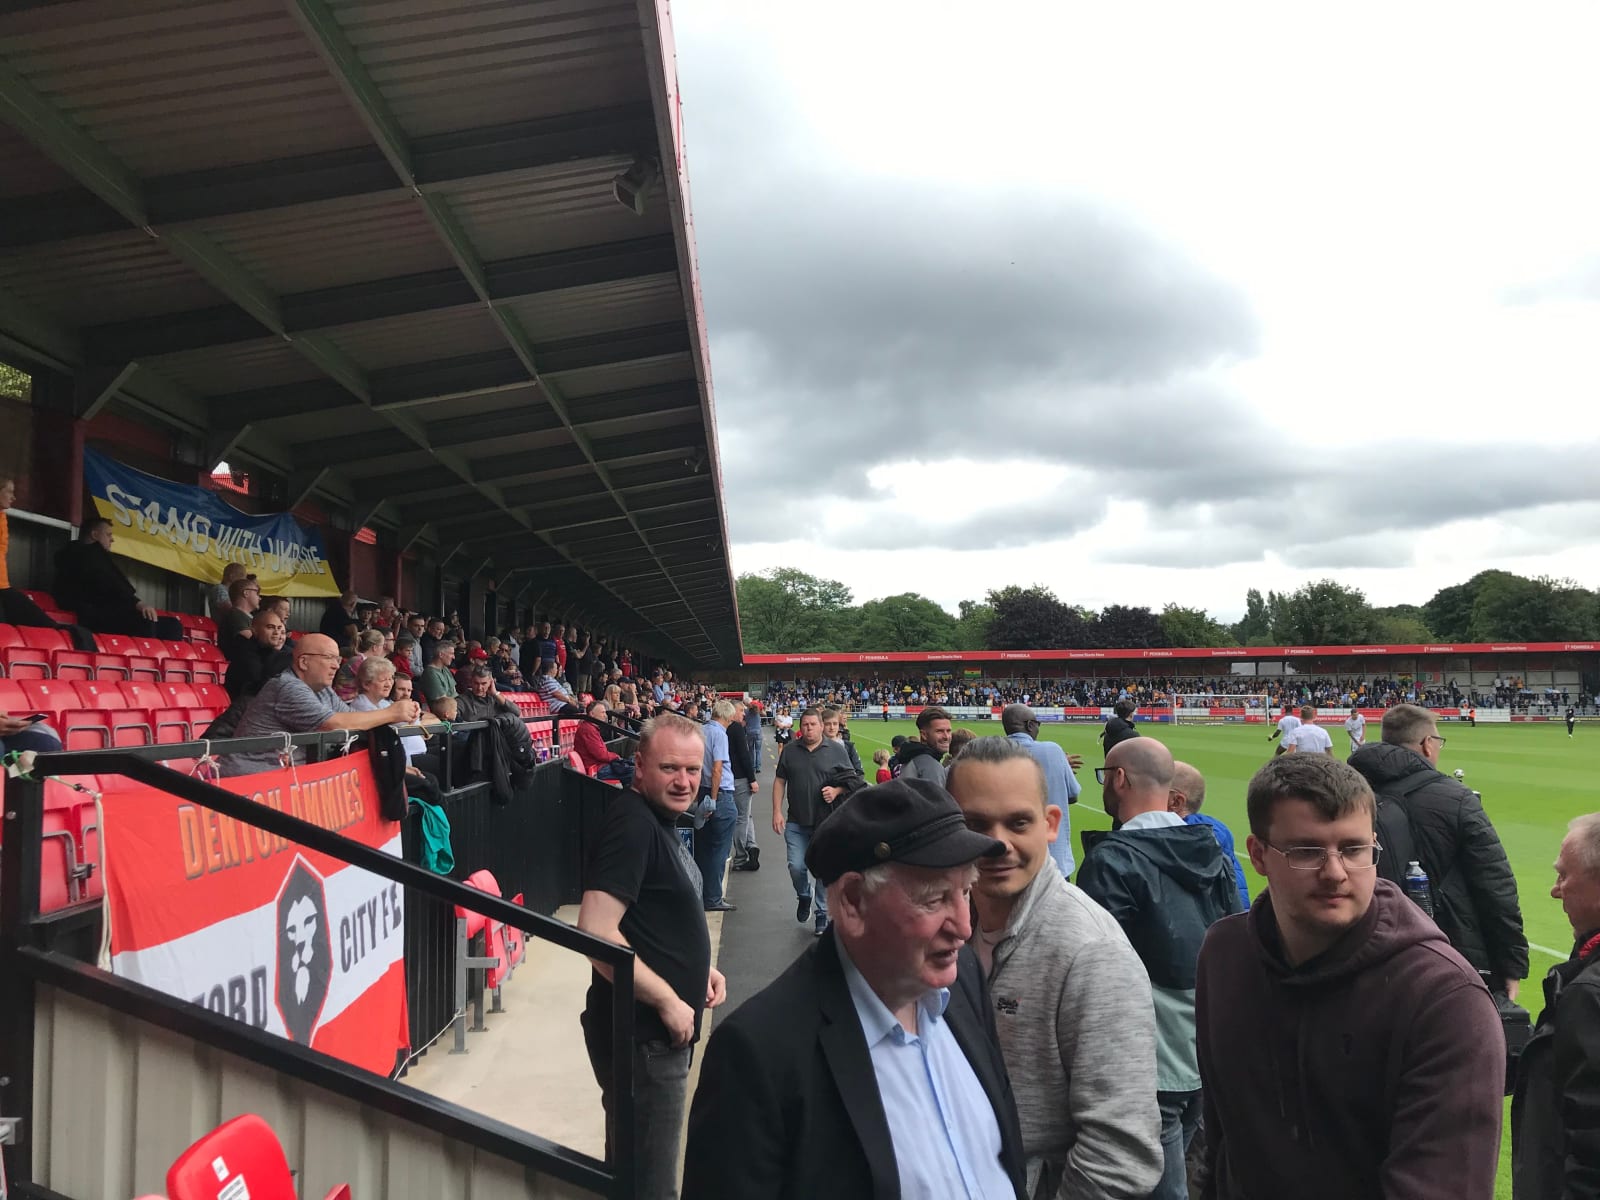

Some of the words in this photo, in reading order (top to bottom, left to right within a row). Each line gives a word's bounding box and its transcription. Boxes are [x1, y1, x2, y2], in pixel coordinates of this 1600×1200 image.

[105, 483, 212, 553] STAND
[215, 523, 265, 570] WITH
[192, 965, 268, 1031] ORD
[339, 895, 377, 974] CITY
